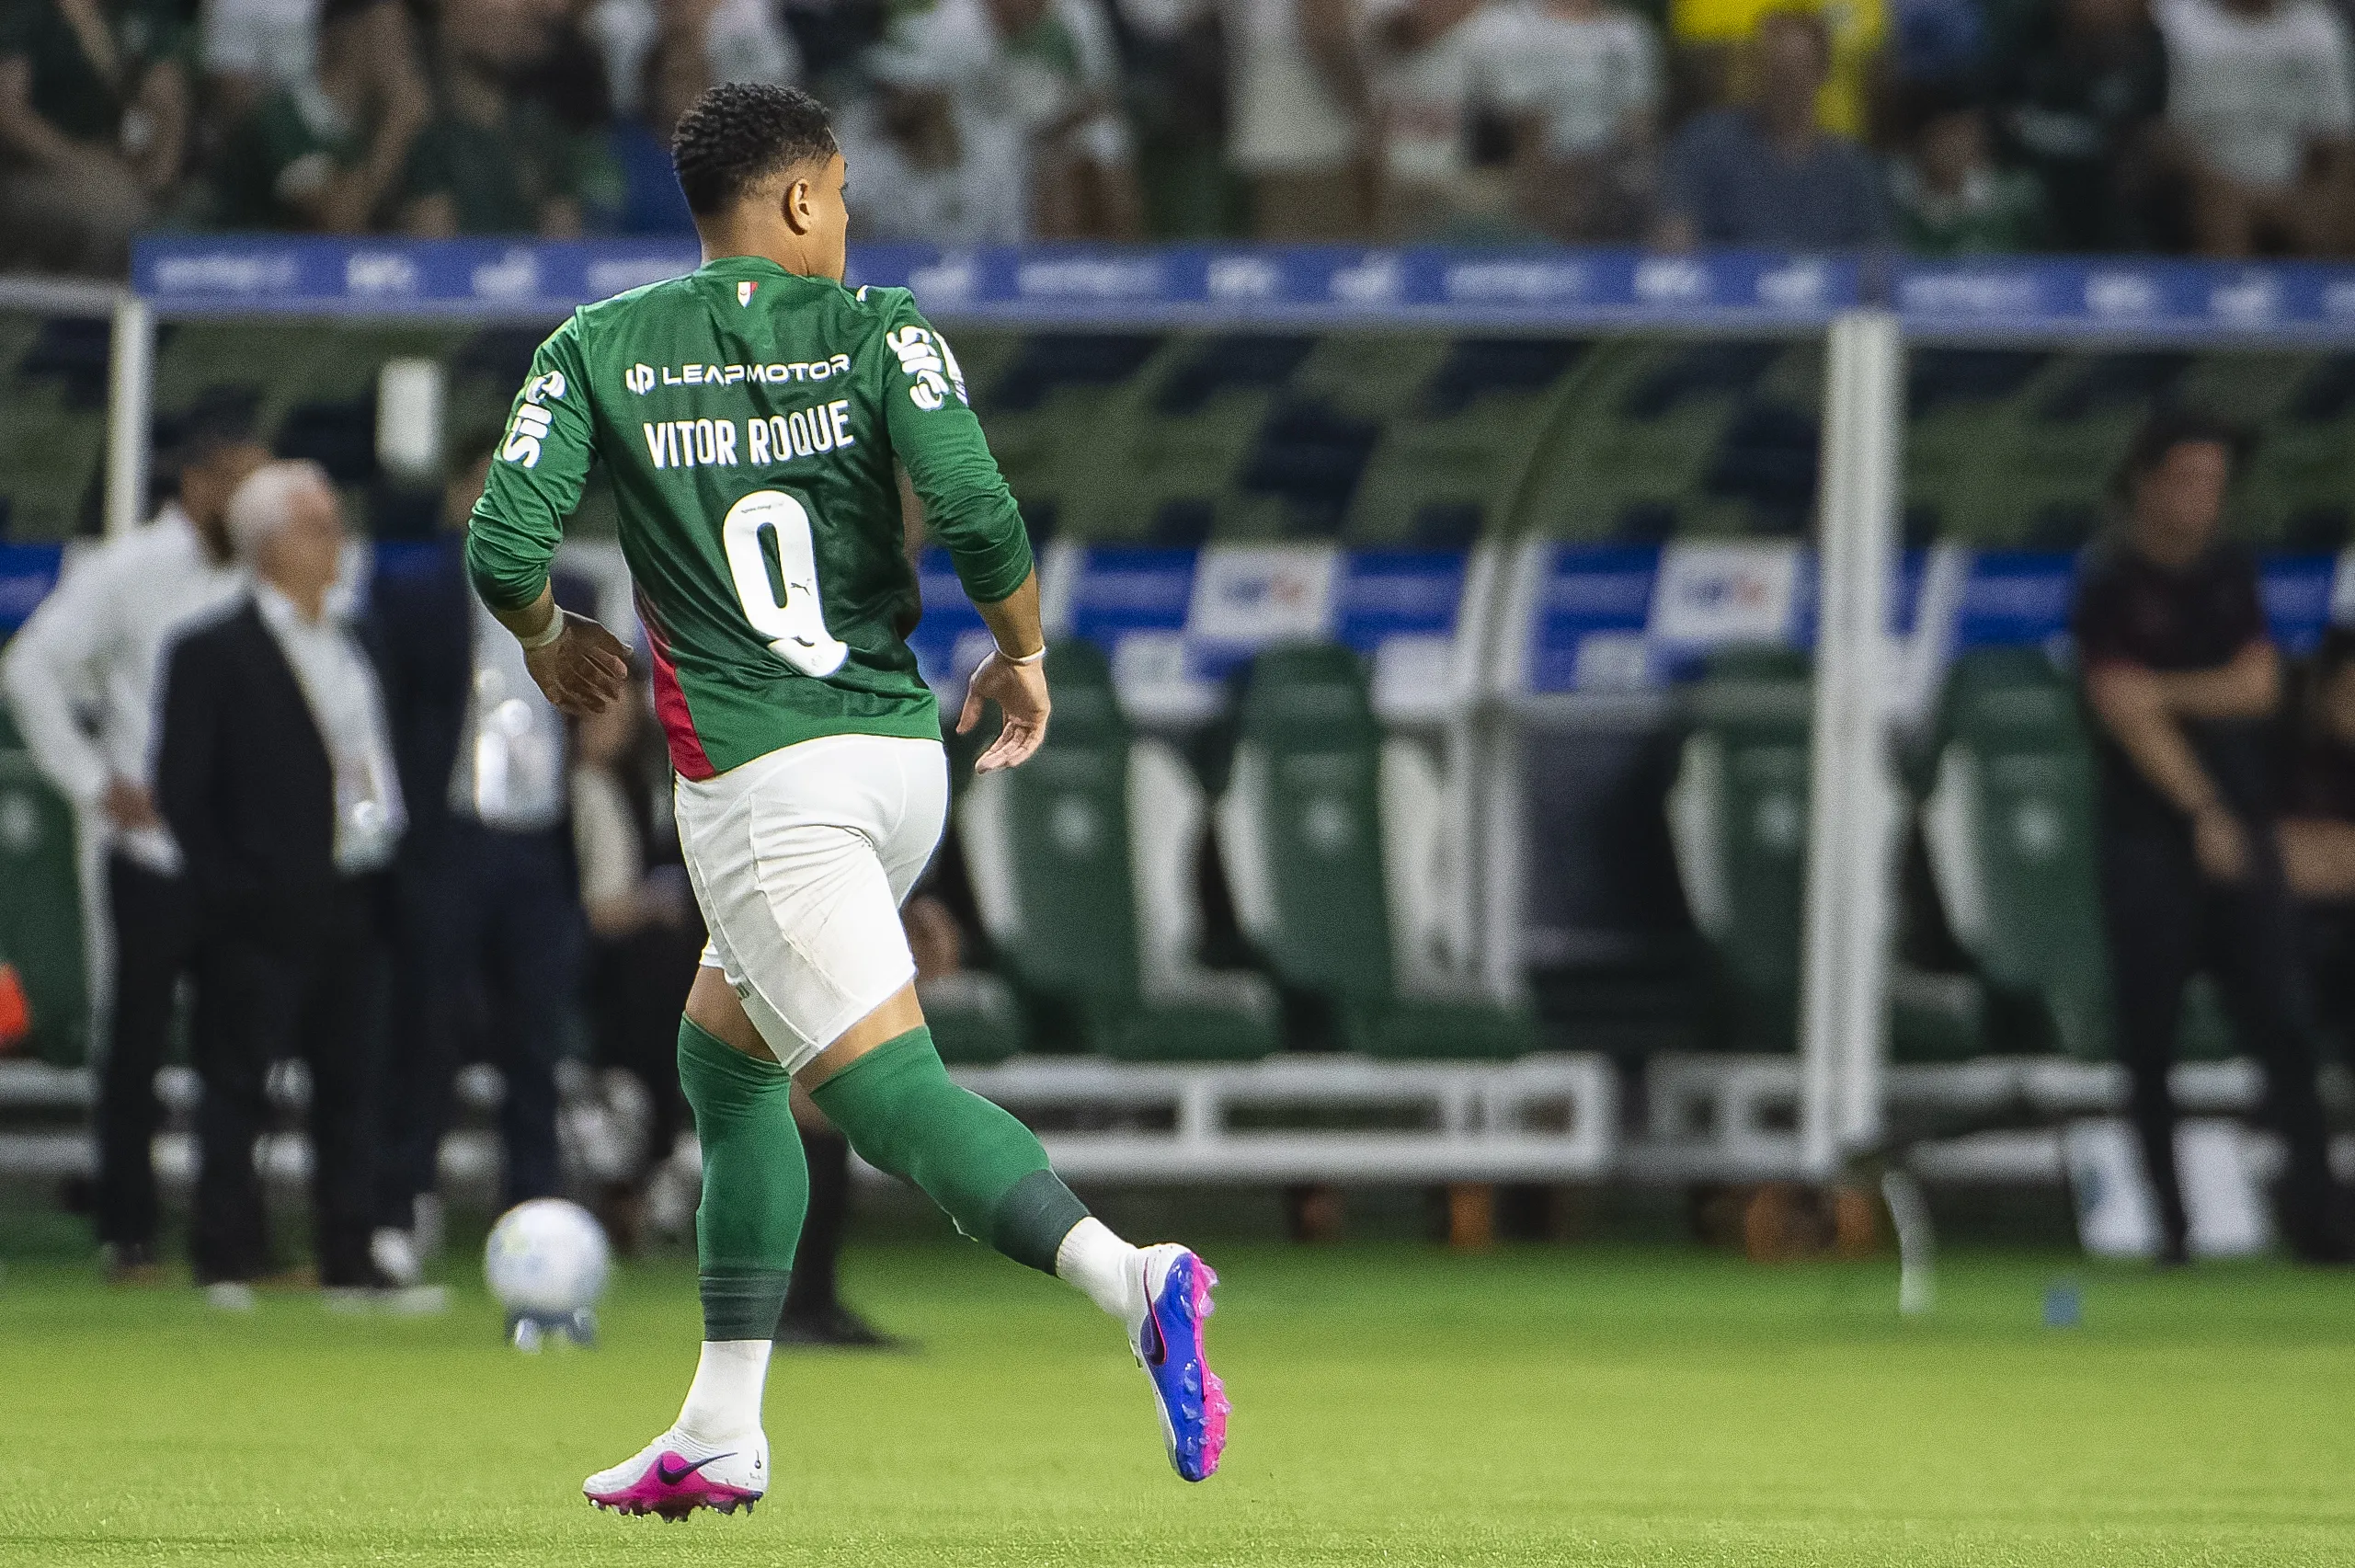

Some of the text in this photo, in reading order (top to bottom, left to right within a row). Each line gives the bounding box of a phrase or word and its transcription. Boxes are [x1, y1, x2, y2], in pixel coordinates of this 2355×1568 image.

[662, 352, 852, 387] LEAPMOTOR
[643, 398, 856, 470] VITOR ROQUE
